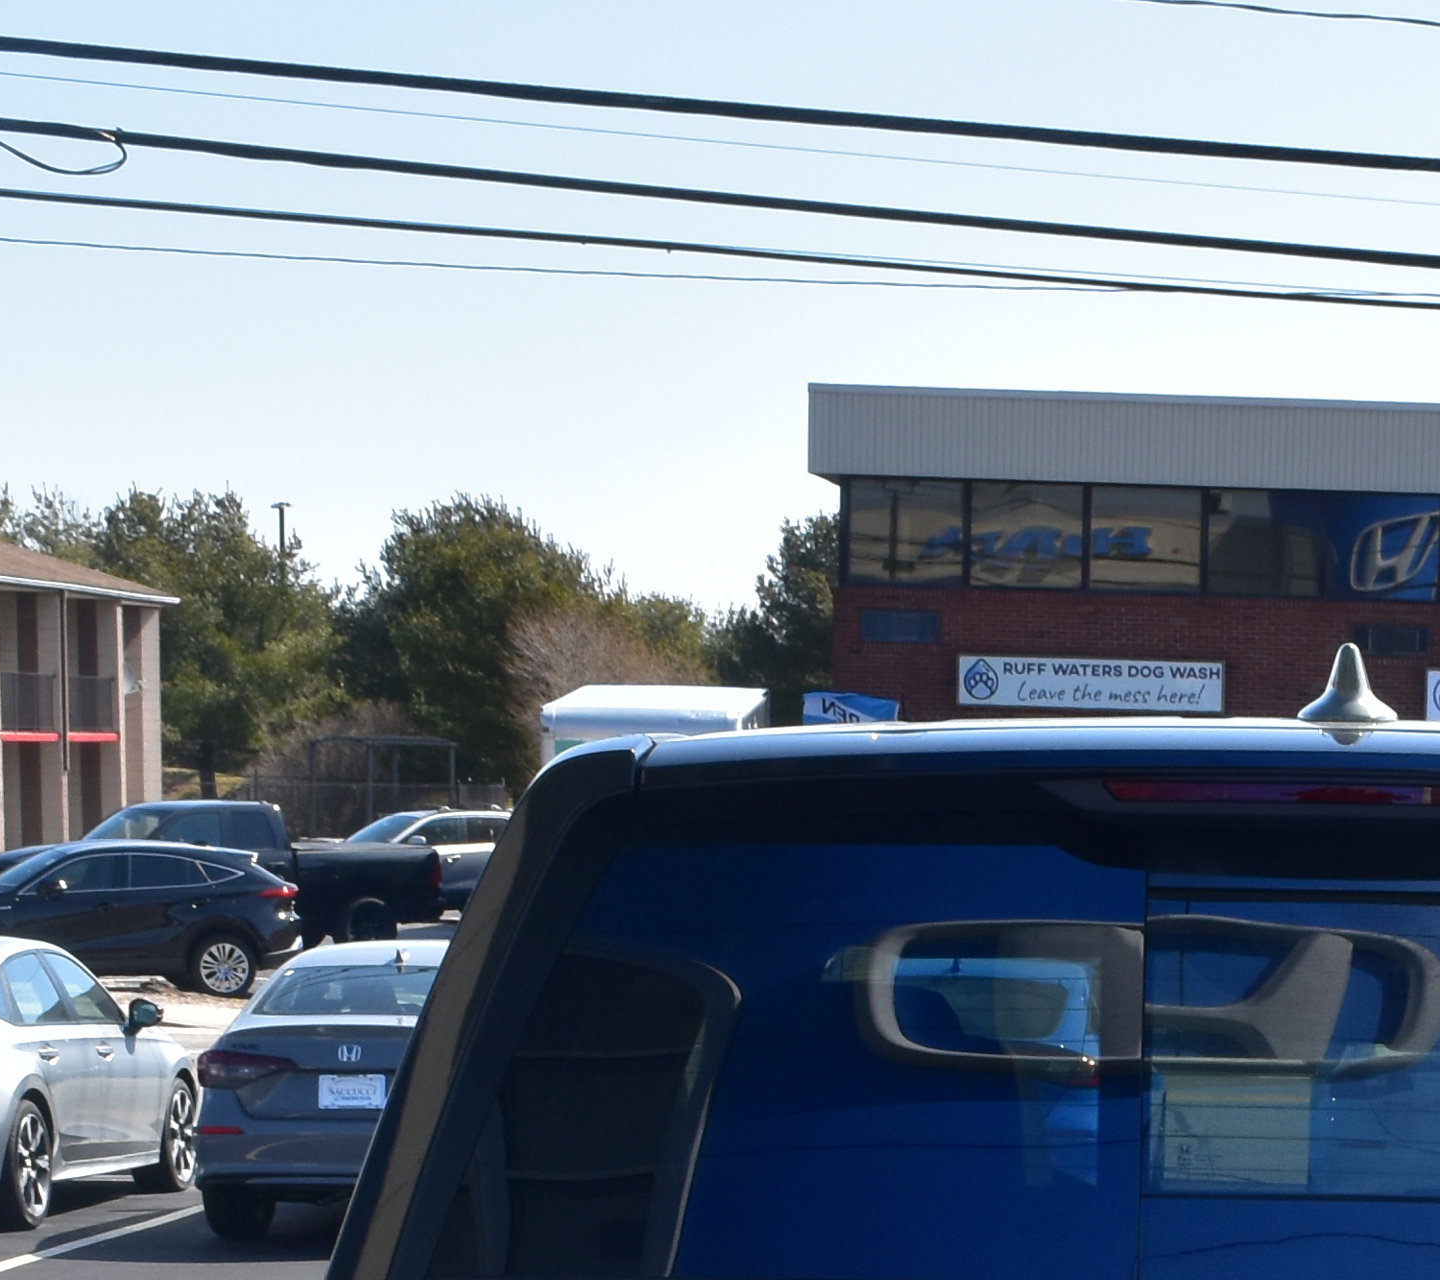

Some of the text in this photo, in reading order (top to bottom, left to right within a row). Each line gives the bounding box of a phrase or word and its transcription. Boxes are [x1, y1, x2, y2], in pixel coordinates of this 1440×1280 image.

[1003, 662, 1221, 681] RUFF WATERS DOG WASH
[1017, 681, 1206, 706] Leave the mess here!
